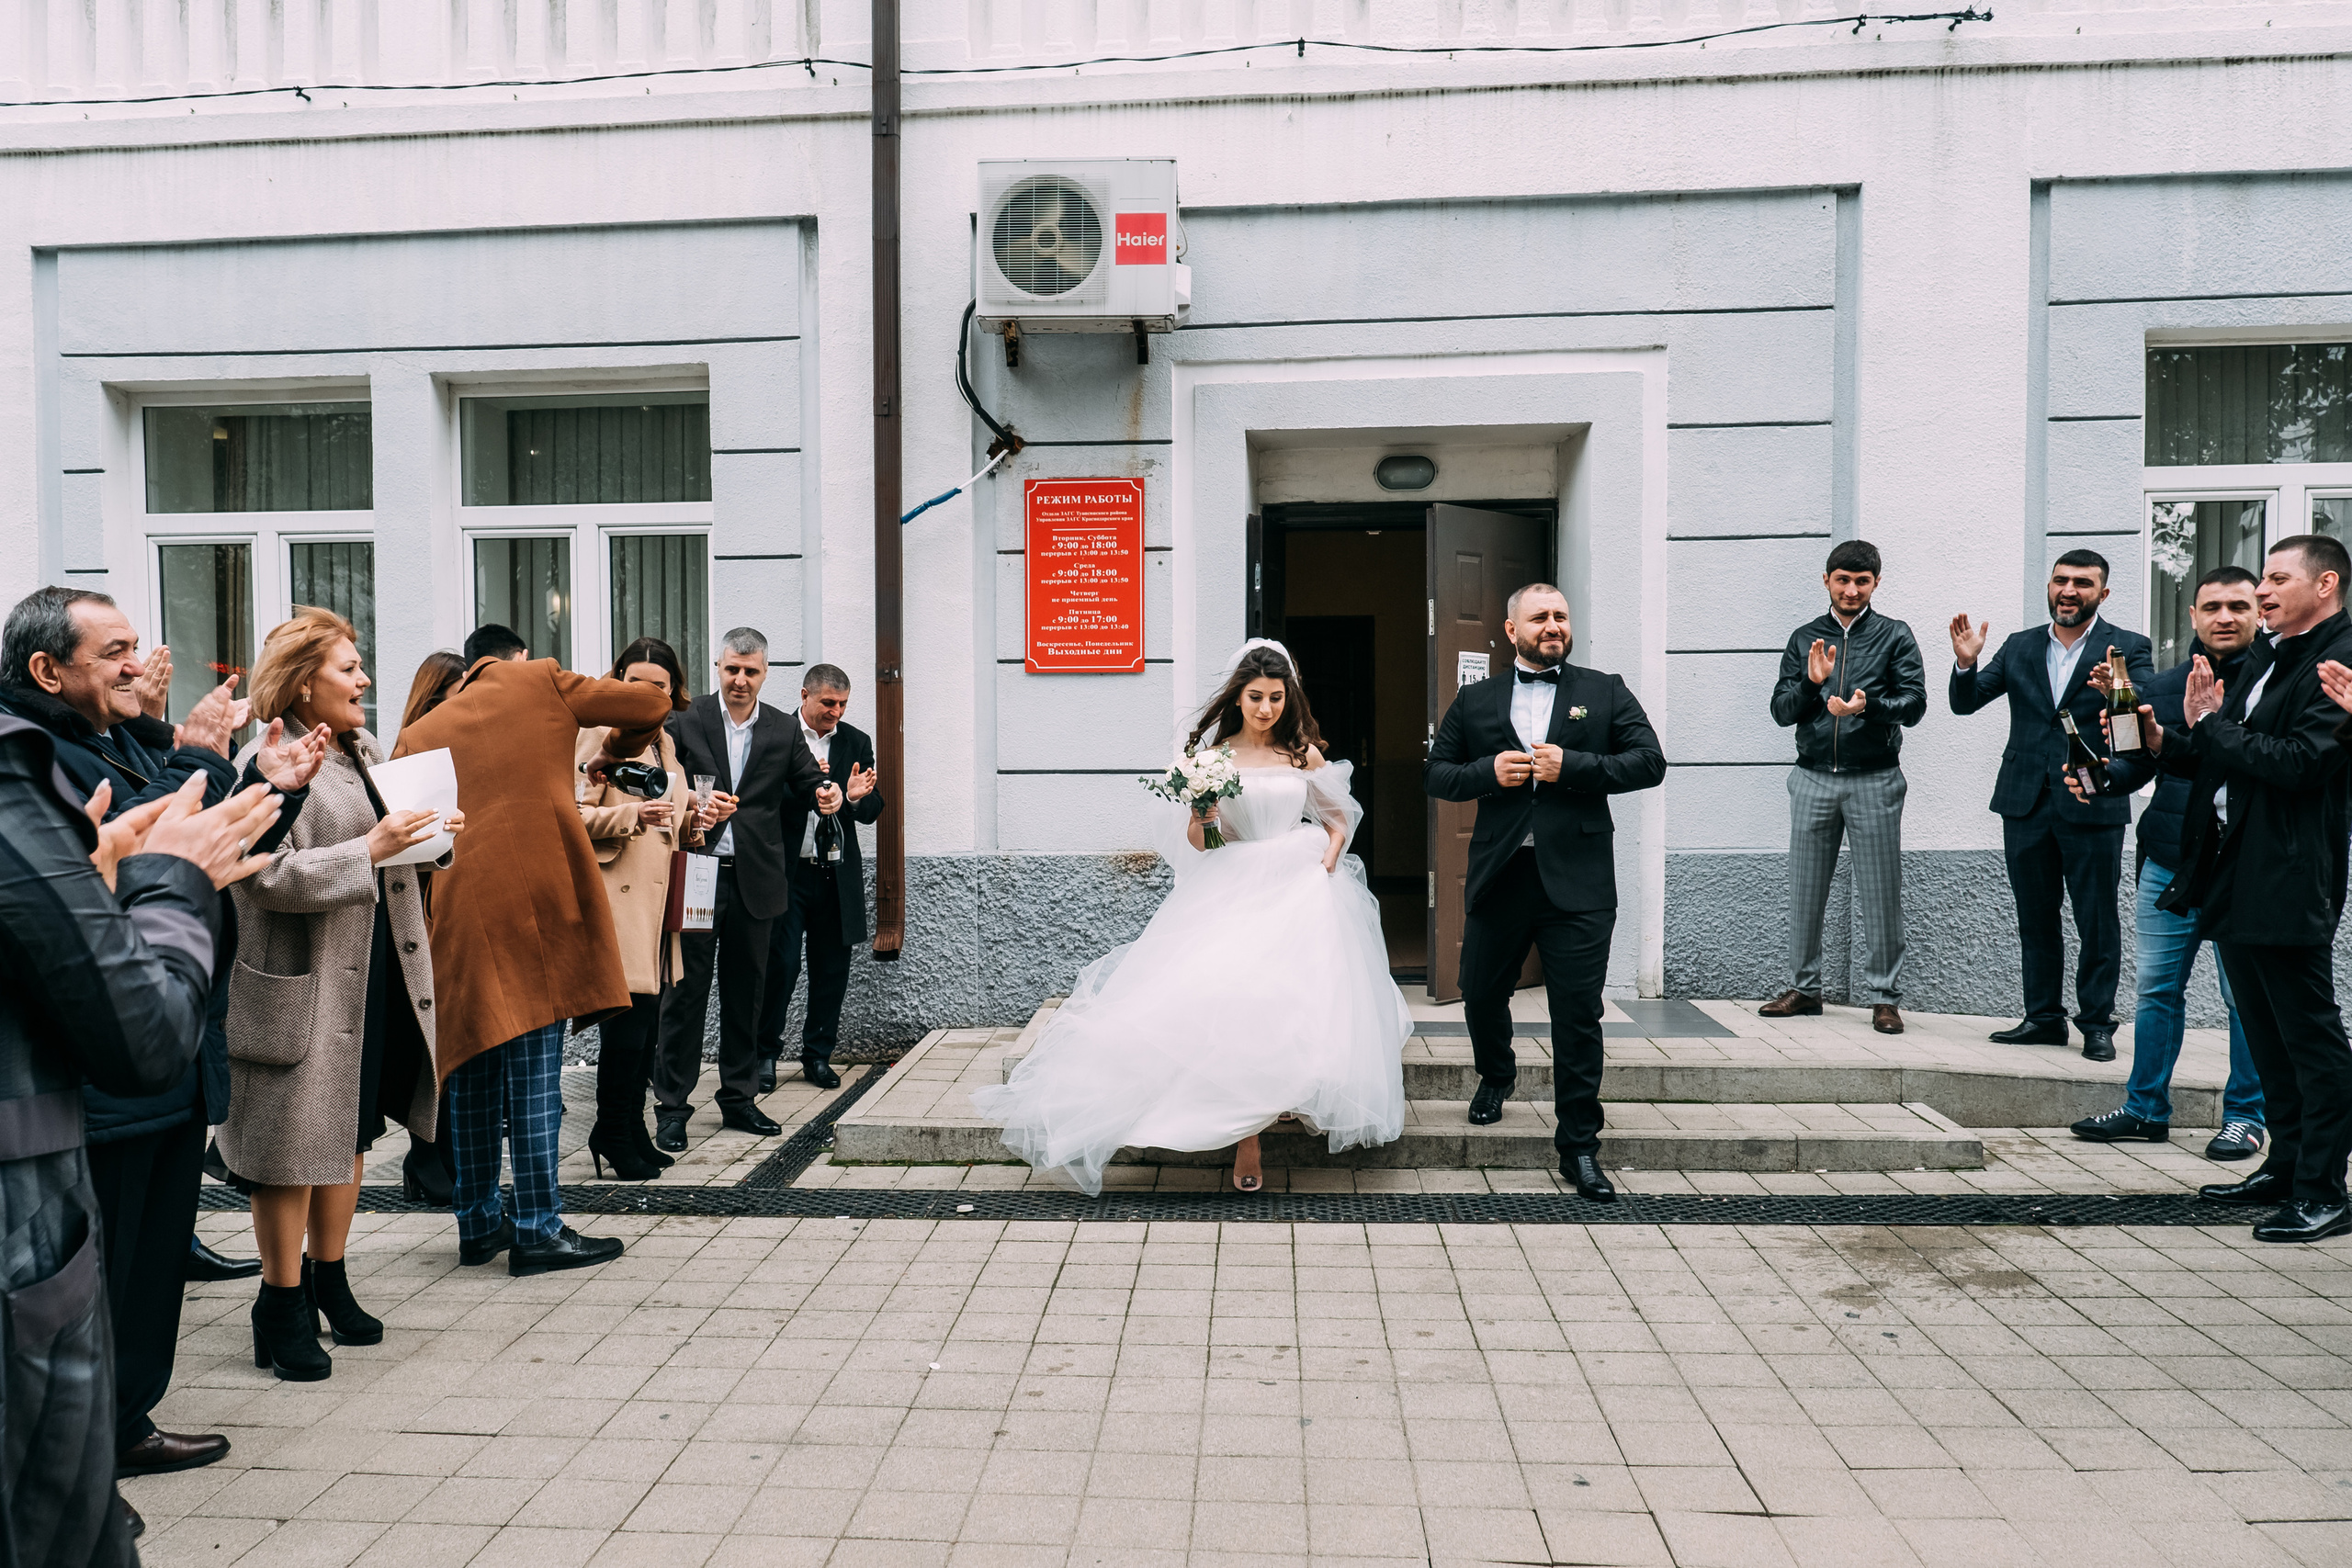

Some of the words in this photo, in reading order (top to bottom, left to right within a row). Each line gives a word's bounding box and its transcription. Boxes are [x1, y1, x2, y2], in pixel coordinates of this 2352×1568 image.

[1117, 232, 1165, 246] Haier
[1036, 496, 1080, 504] РЕЖИМ
[1085, 495, 1132, 503] РАБОТЫ
